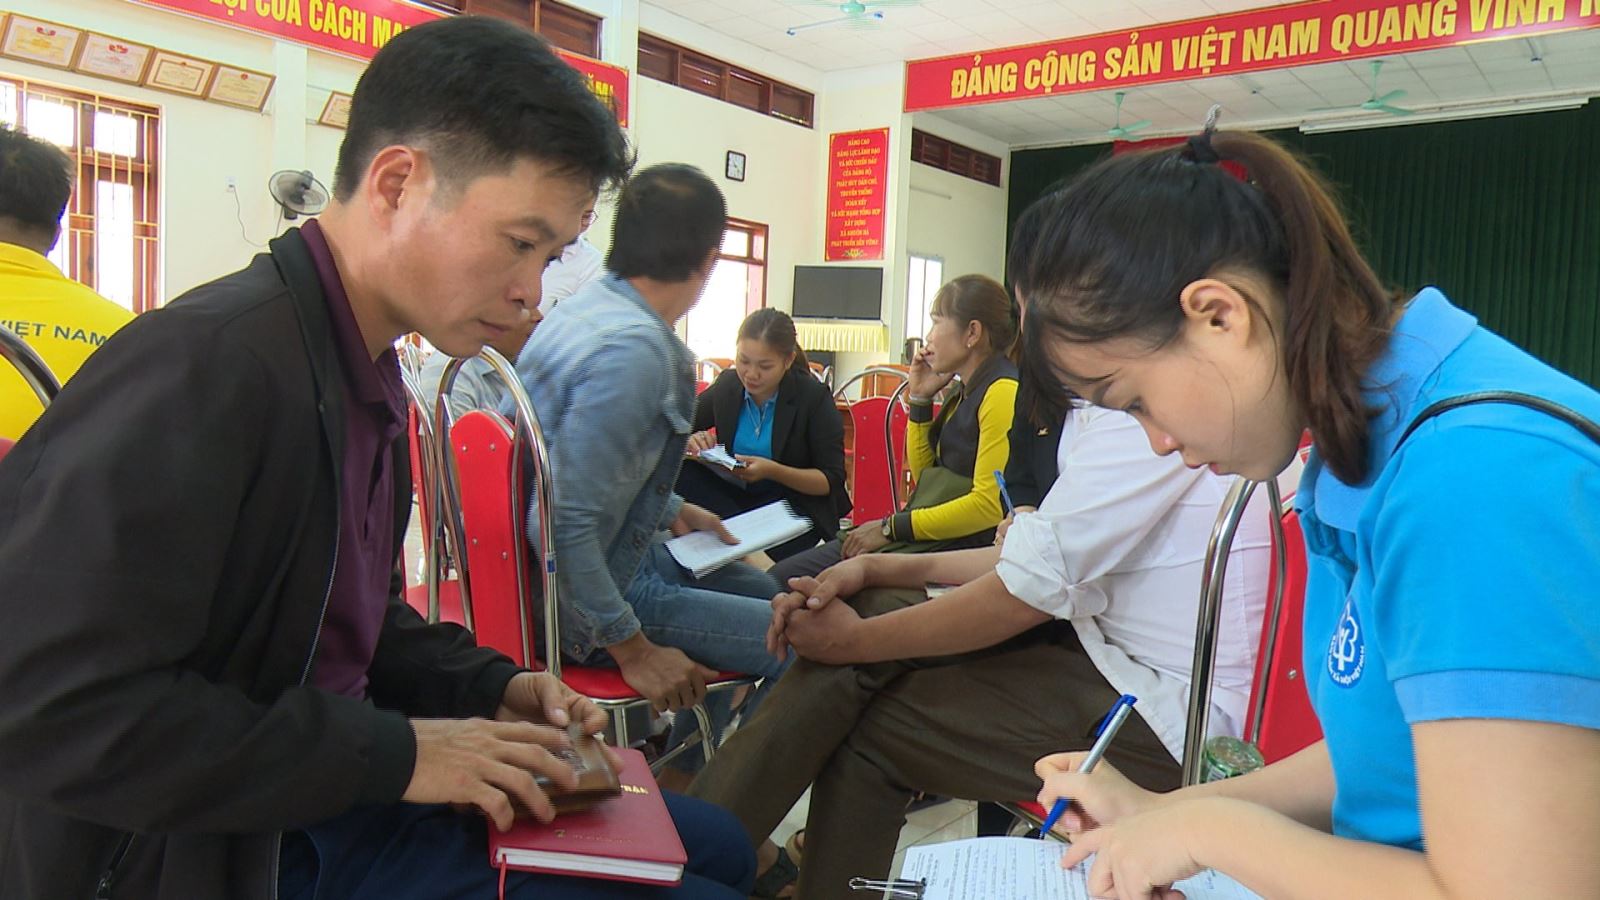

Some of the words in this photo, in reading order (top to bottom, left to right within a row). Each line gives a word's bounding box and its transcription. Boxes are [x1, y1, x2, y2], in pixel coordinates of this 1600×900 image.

[308, 0, 366, 44] CÁCH
[951, 54, 1018, 98] ĐẢNG
[1024, 50, 1097, 93] CỘNG
[1103, 33, 1164, 80] SẢN
[1172, 26, 1236, 75] VIỆT
[1242, 18, 1321, 63] NAM
[1331, 0, 1457, 55] QUANG
[54, 326, 107, 346] NAM
